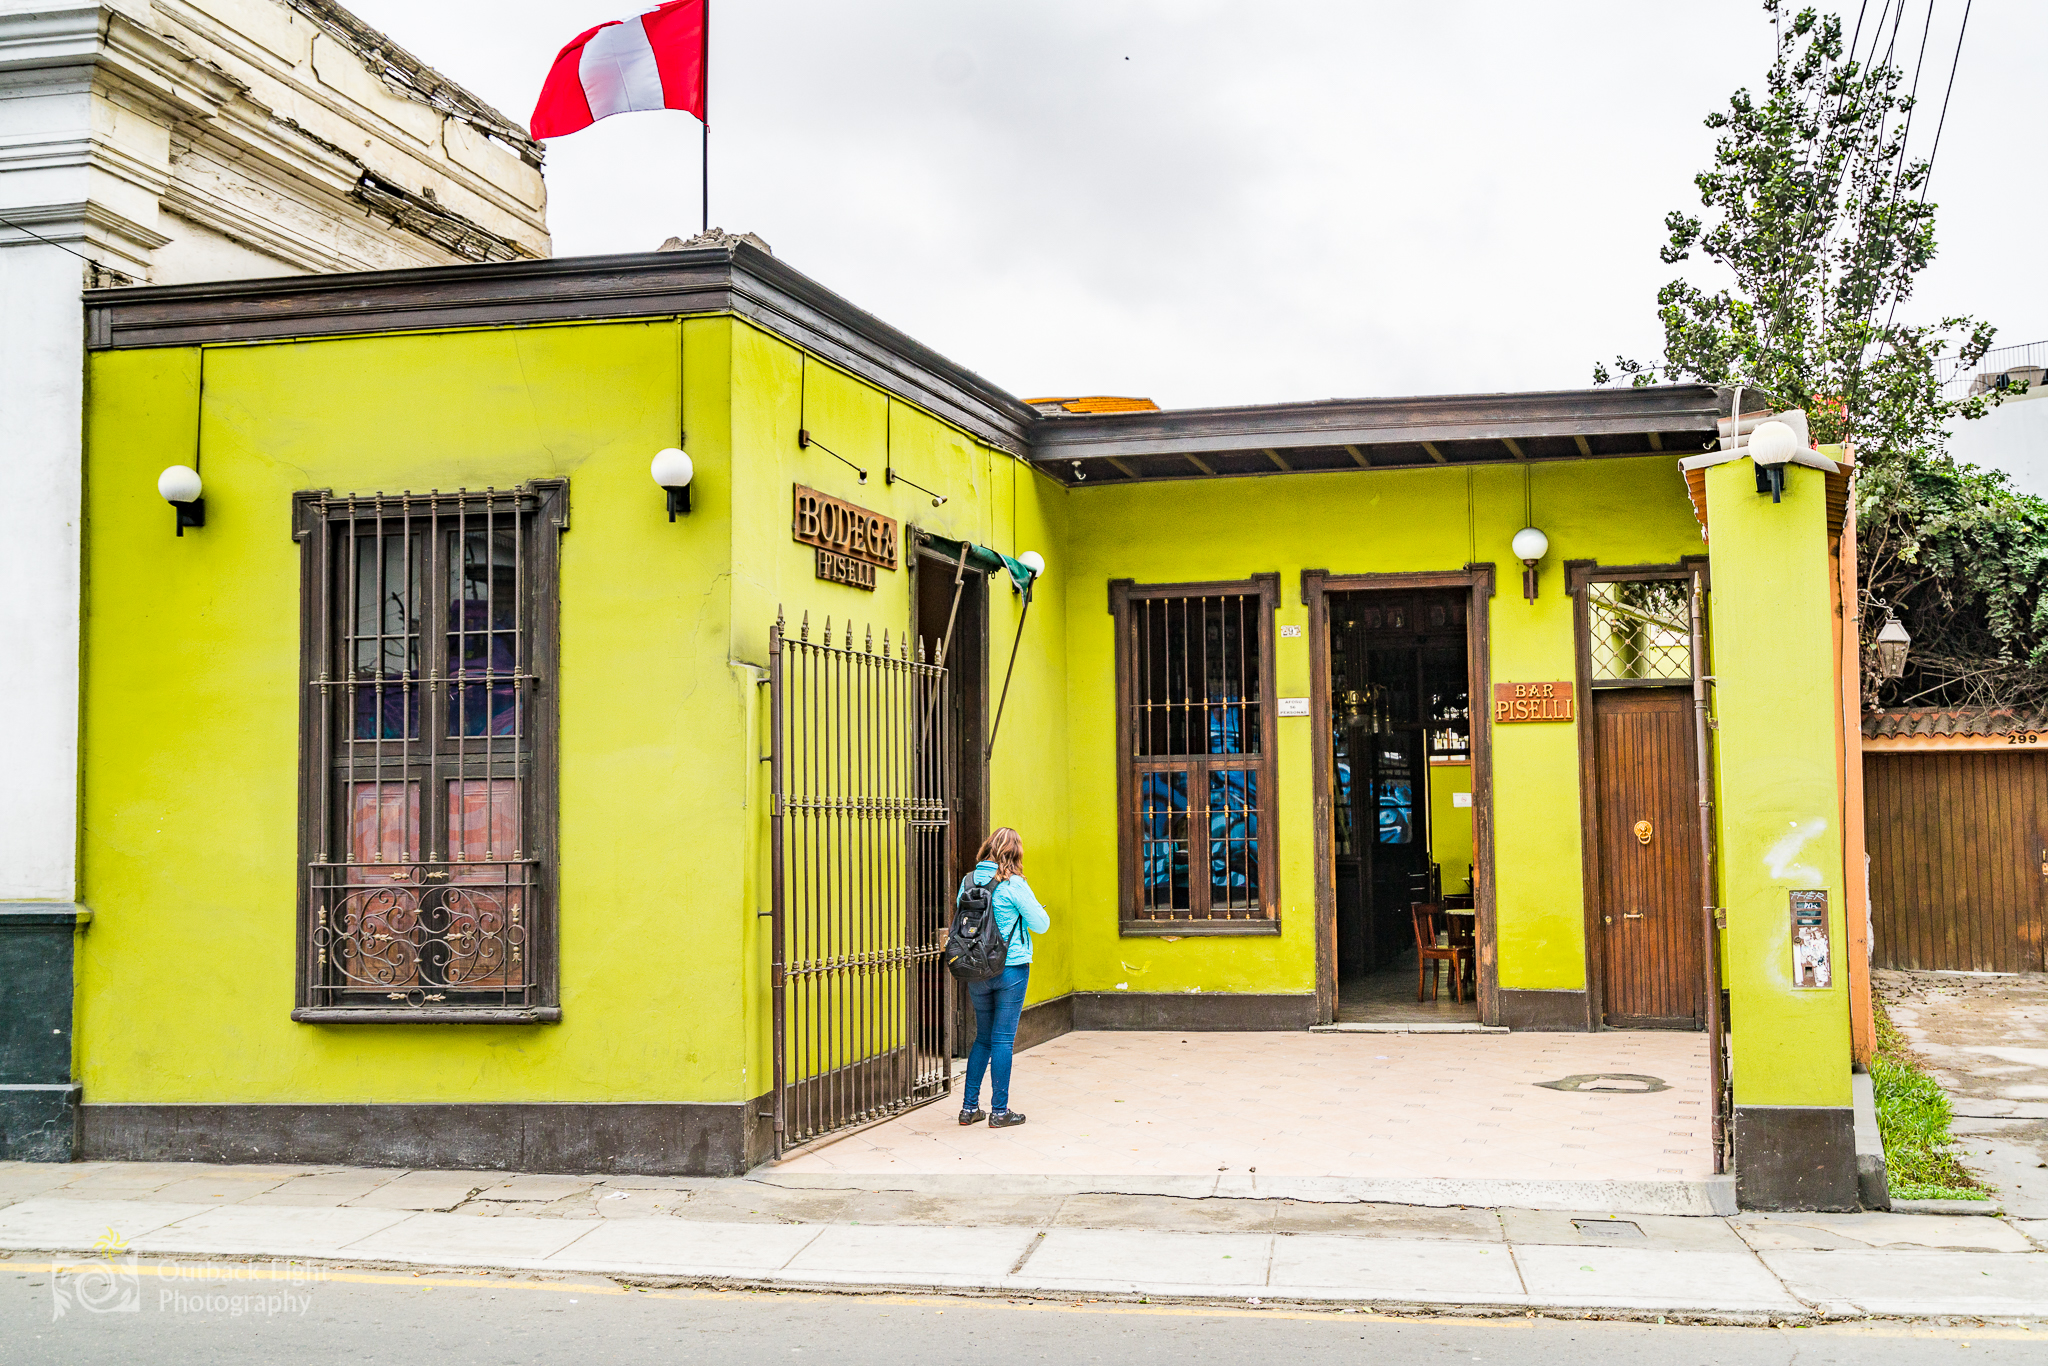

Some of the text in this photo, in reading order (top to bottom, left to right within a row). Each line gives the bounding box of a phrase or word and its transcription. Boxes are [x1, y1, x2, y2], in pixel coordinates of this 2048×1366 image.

[798, 494, 897, 561] BODEGA
[819, 552, 878, 588] PISELLI
[1515, 684, 1554, 698] BAR
[1496, 699, 1572, 720] PISELLI
[2008, 735, 2038, 744] 299
